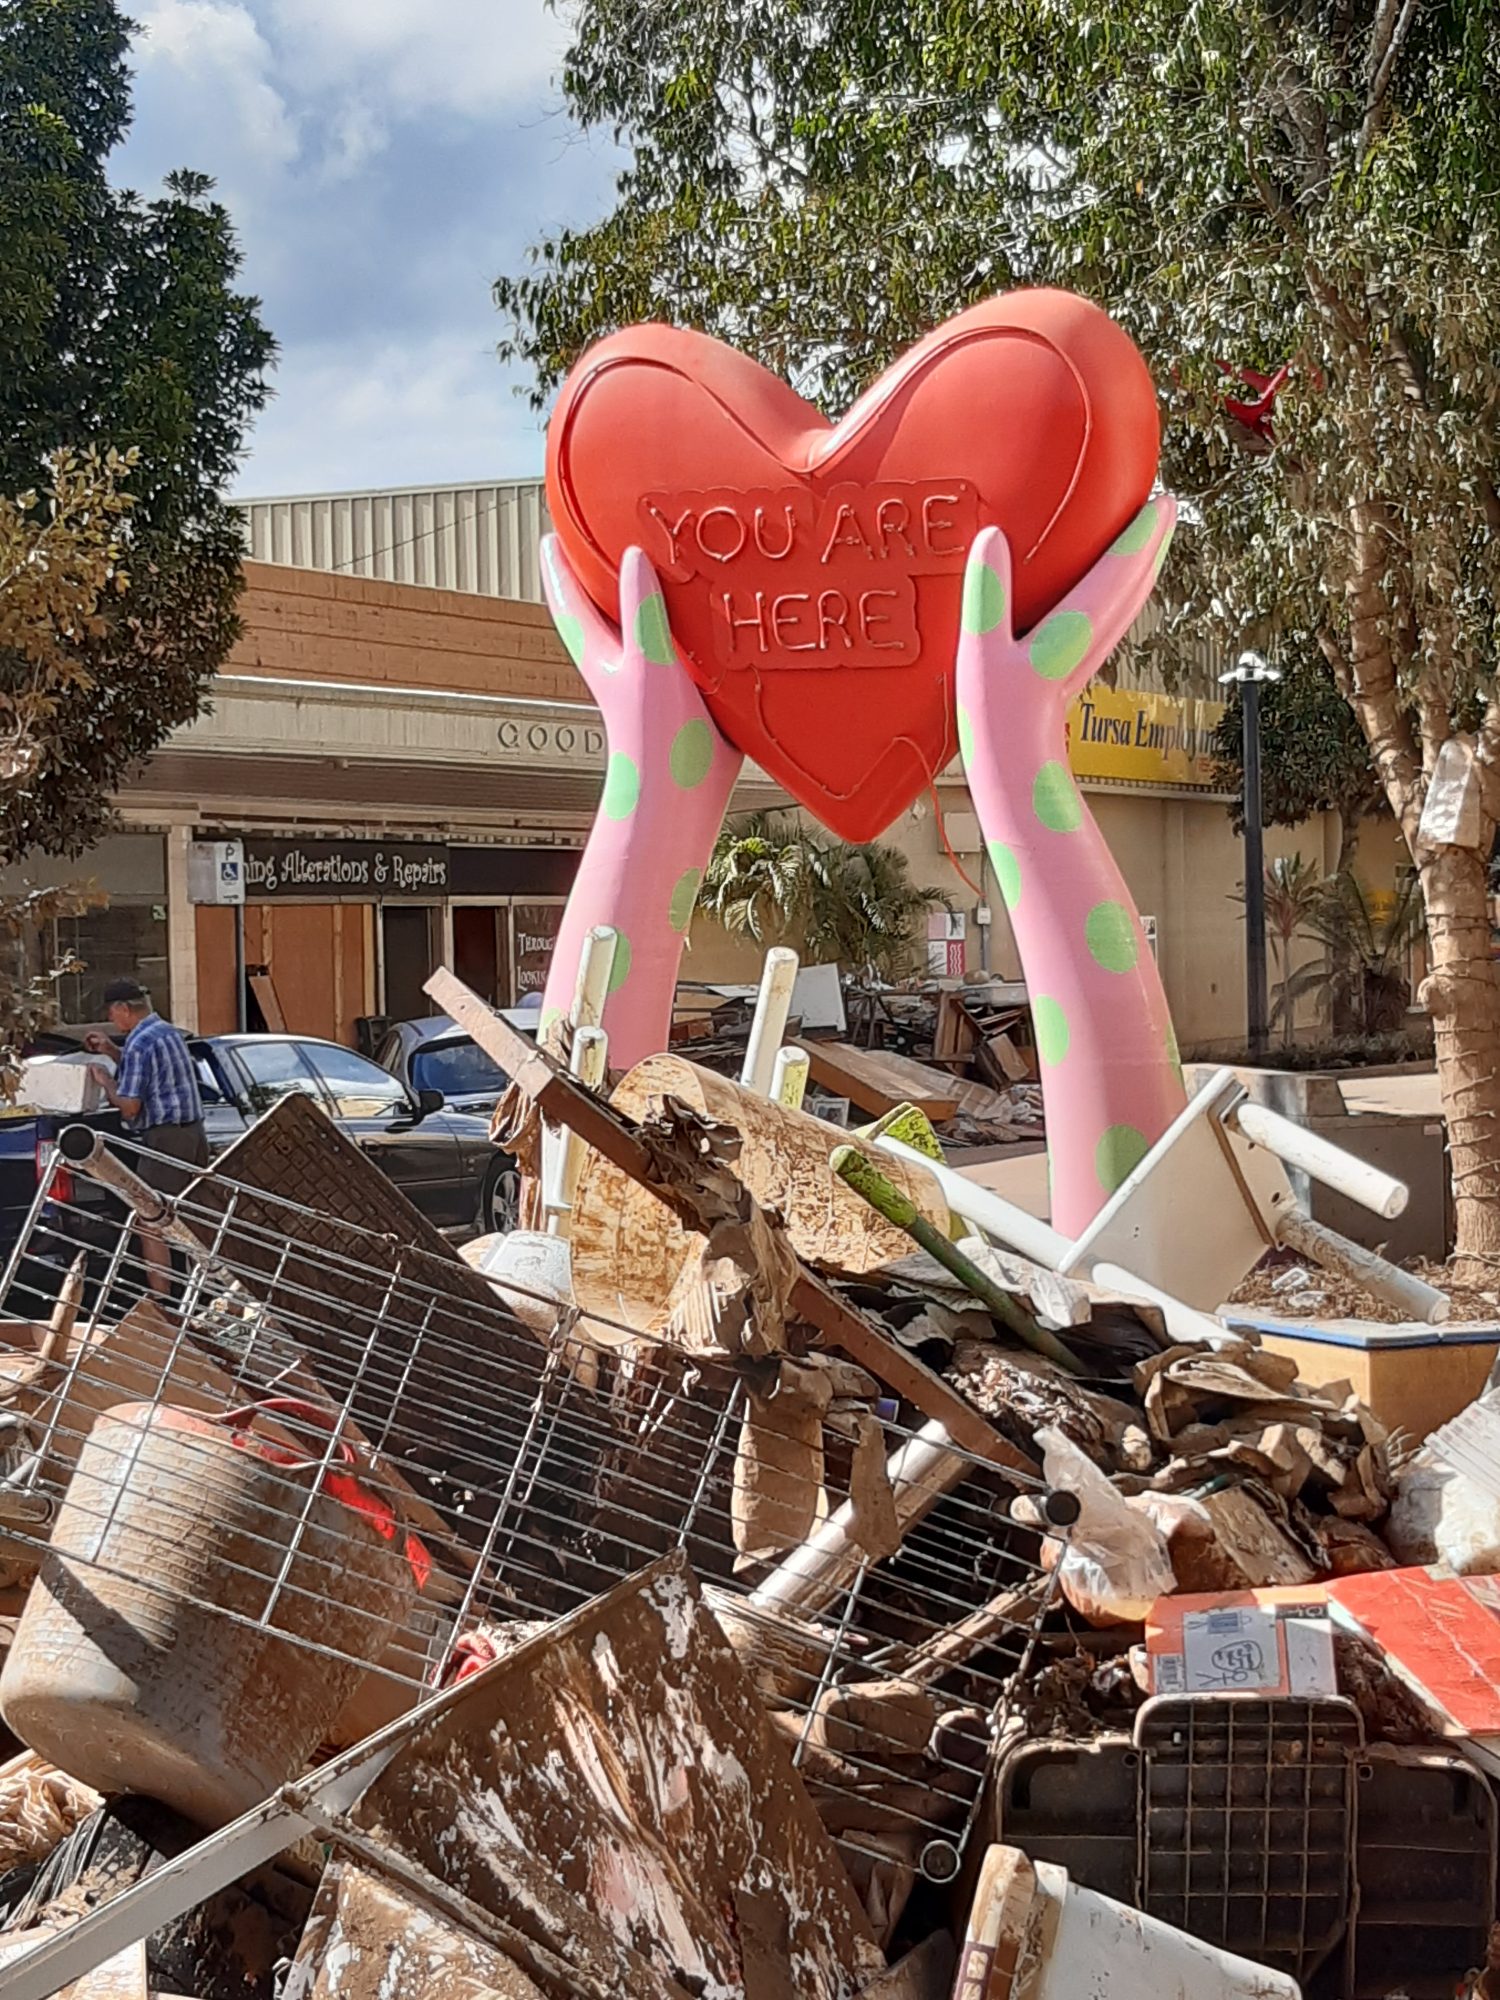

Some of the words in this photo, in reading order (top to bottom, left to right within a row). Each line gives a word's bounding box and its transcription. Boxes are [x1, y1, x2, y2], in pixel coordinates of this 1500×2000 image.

[649, 503, 796, 564] YOU
[820, 494, 966, 564] ARE
[723, 589, 904, 653] HERE
[497, 721, 603, 755] GOOD
[1080, 703, 1131, 747] Tursa
[225, 845, 235, 861] P
[281, 850, 369, 884] Alterations
[374, 852, 389, 883] &
[392, 855, 447, 891] Repairs
